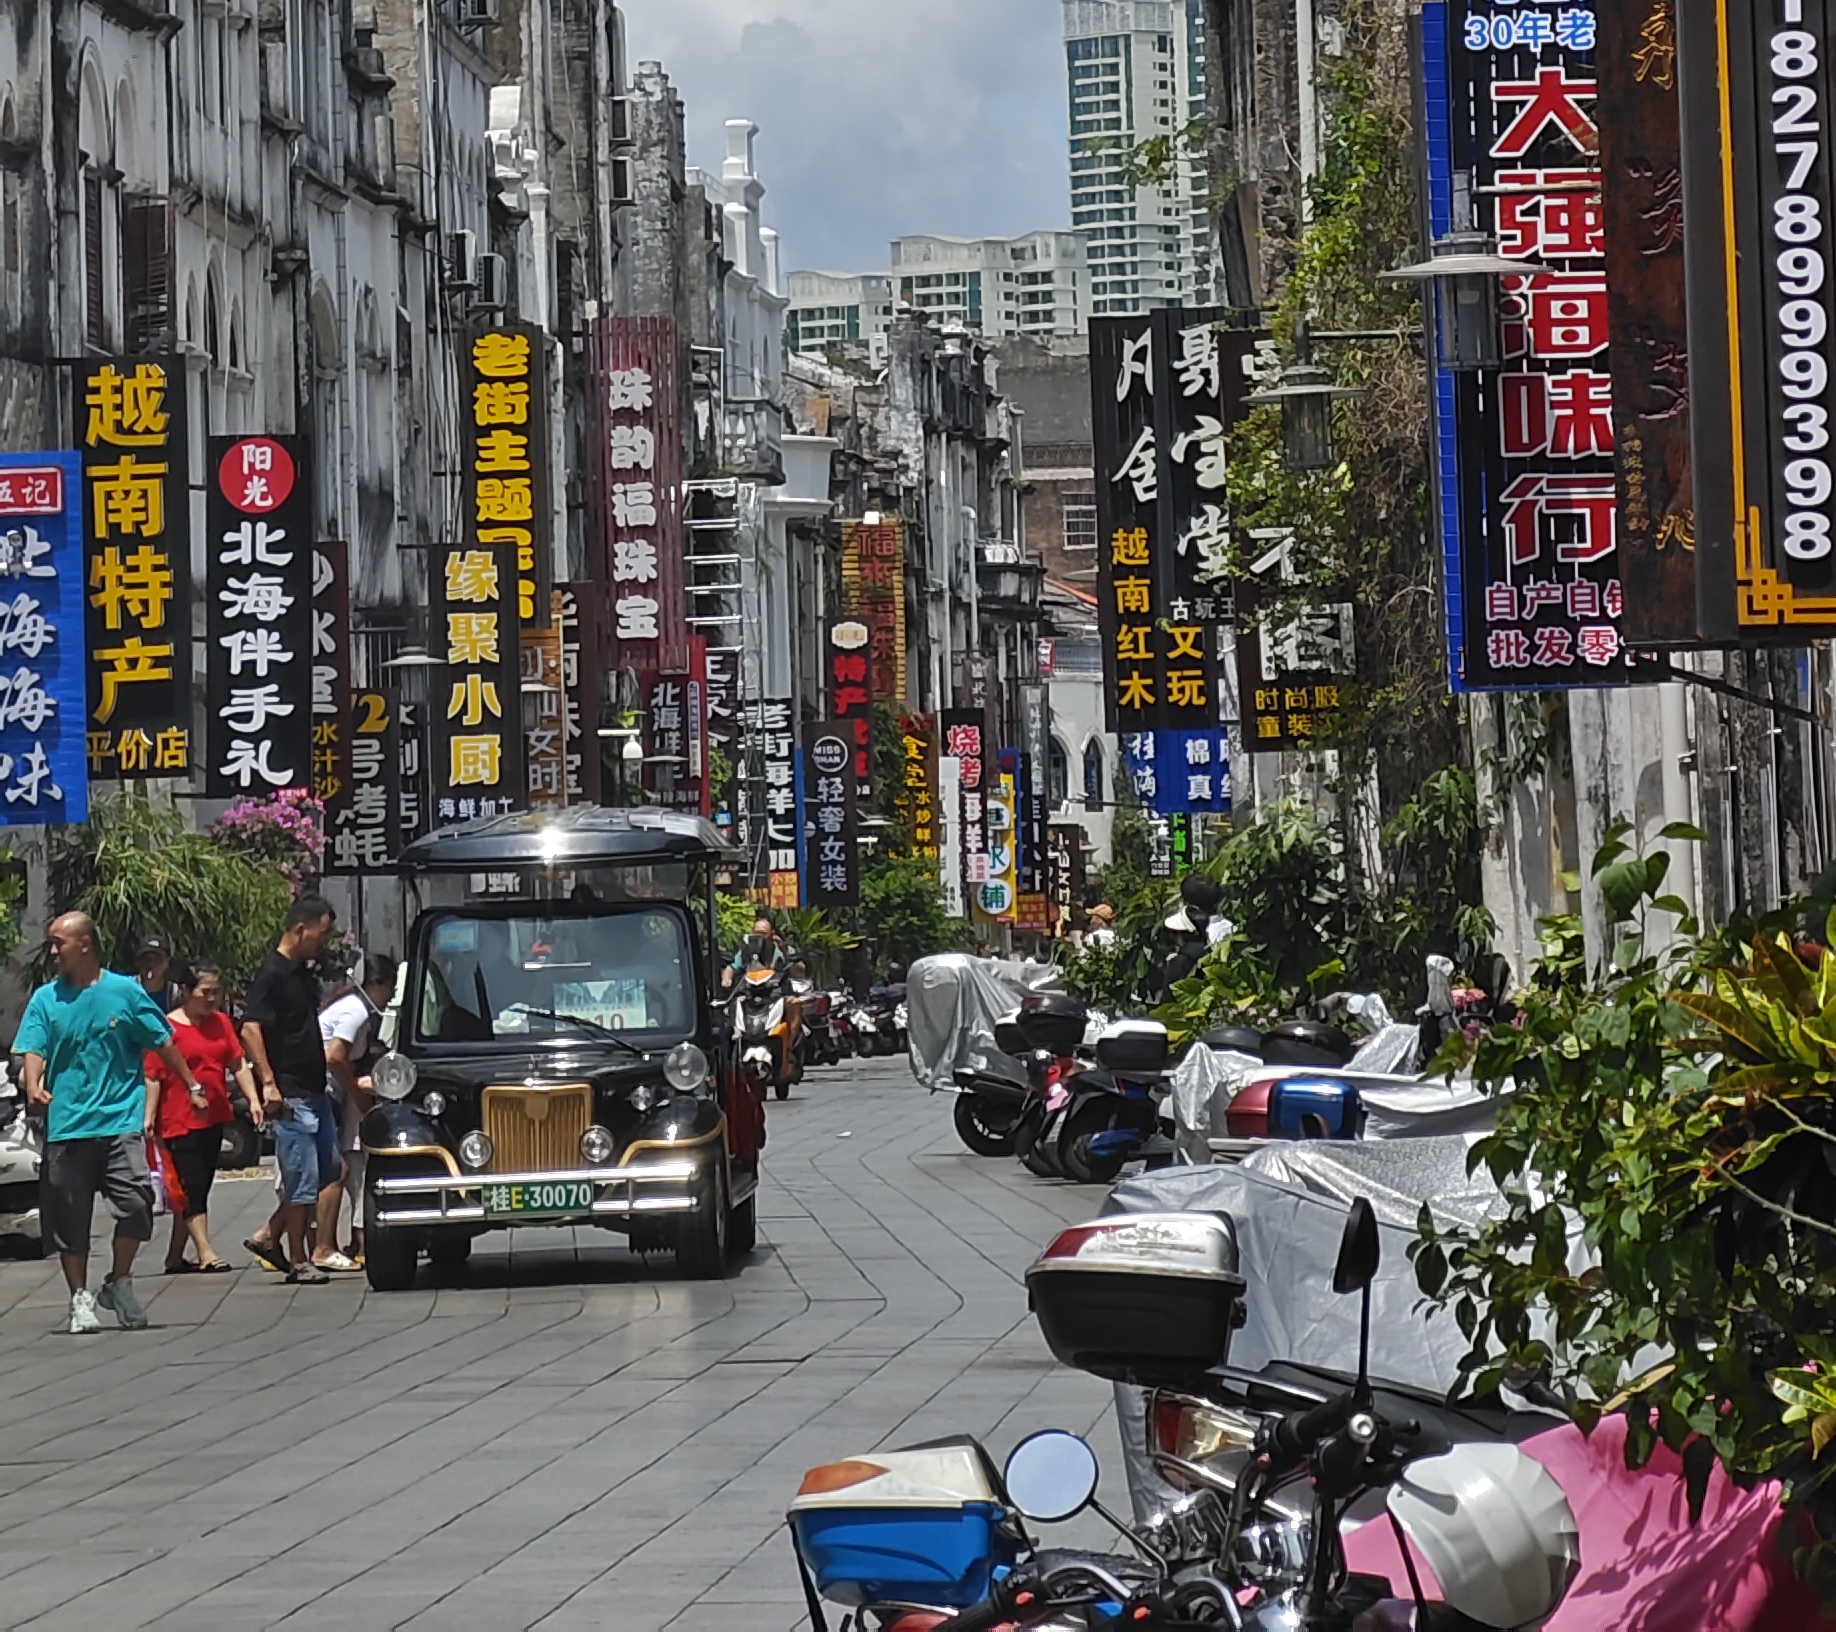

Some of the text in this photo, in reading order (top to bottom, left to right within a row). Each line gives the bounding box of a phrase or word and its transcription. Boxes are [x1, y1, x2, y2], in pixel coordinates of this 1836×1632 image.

[1465, 9, 1597, 53] 30年老
[241, 442, 274, 508] 阳光
[608, 367, 660, 640] 珠韵福珠宝
[85, 362, 174, 724] 越南特产
[218, 521, 295, 787] 北海伴手礼
[445, 549, 502, 787] 缘聚小厨
[1111, 526, 1157, 711] 越南红木
[1166, 625, 1208, 707] 文玩
[1487, 625, 1657, 668] 批发零
[87, 727, 190, 771] 平价店
[816, 775, 848, 893] 轻奢女装
